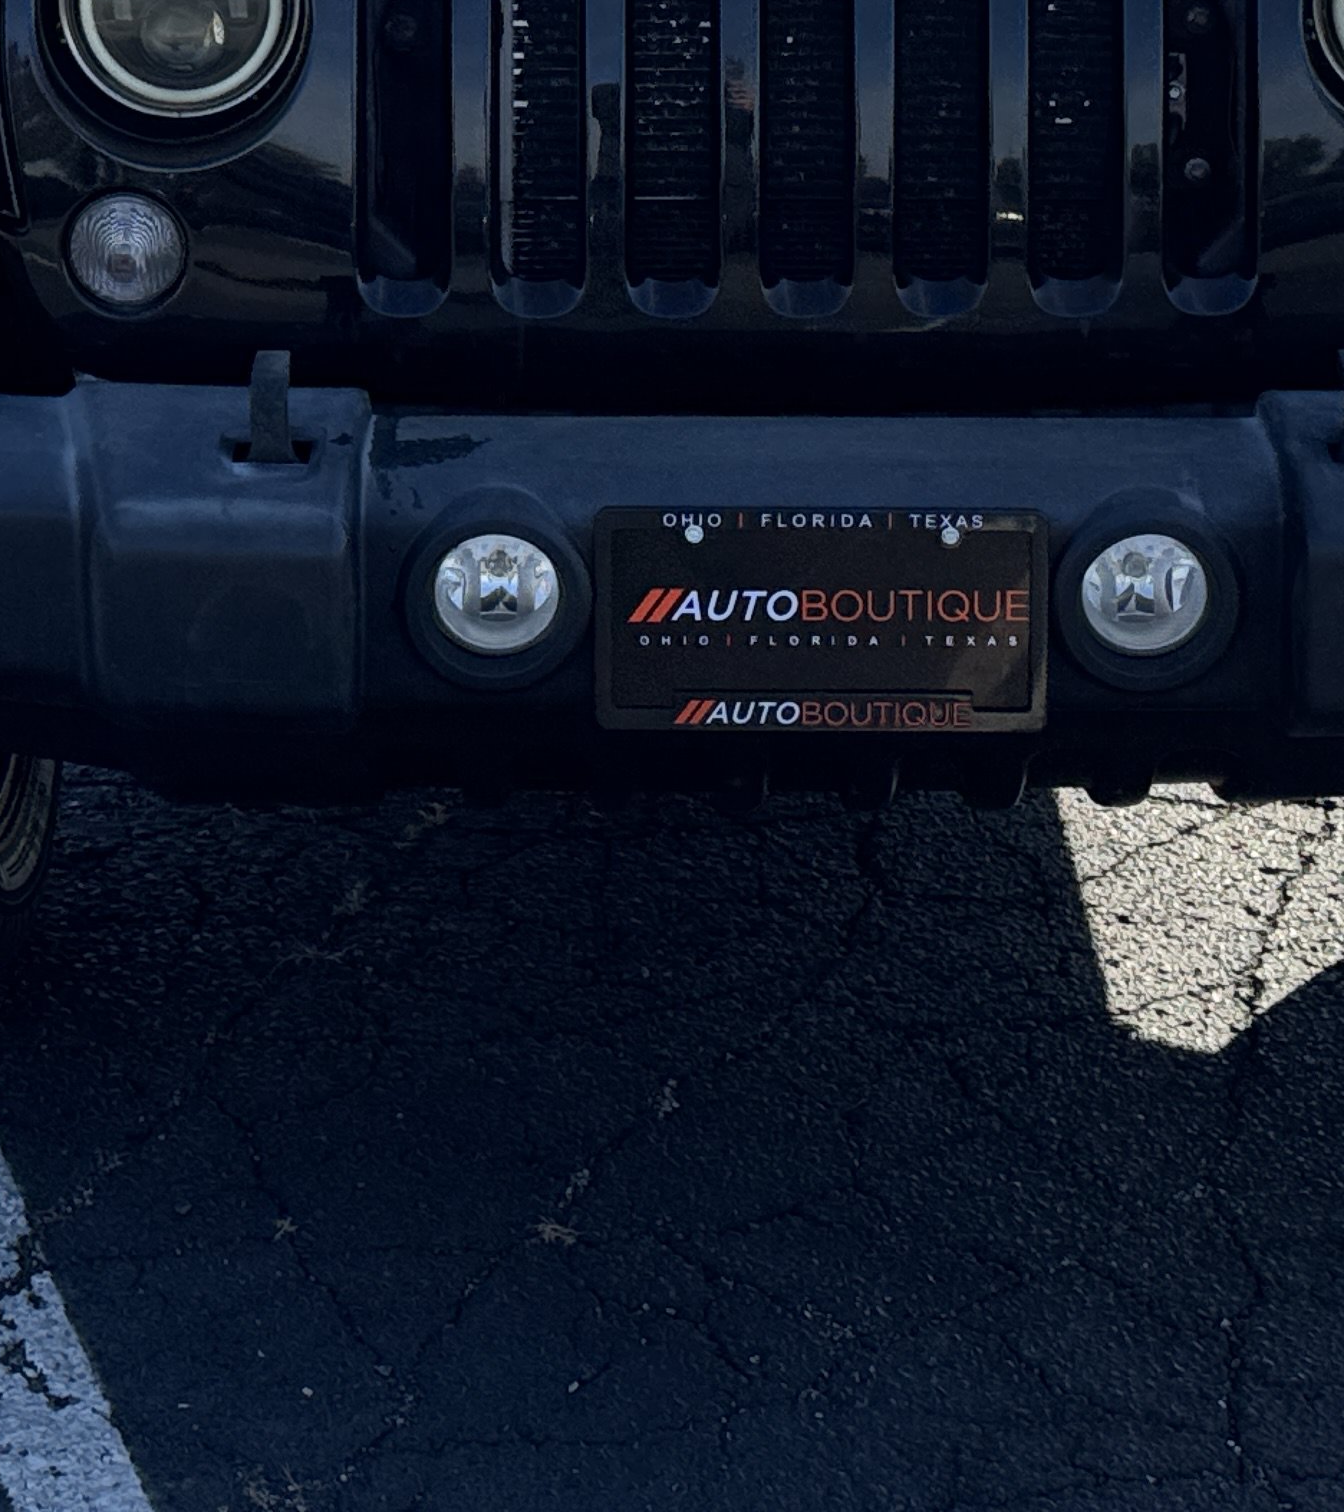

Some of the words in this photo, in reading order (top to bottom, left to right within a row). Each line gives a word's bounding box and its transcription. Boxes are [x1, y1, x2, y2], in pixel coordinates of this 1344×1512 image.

[662, 513, 723, 529] OHIO
[760, 513, 873, 529] FLORIDA
[909, 513, 985, 529] TEXAS
[671, 590, 1029, 623] AUTOBOUTIQUE
[639, 635, 710, 646] OHIO
[750, 635, 880, 646] FLORIDA
[926, 635, 1019, 647] TEXAS
[706, 701, 972, 726] AUTOBOUTIQUE
